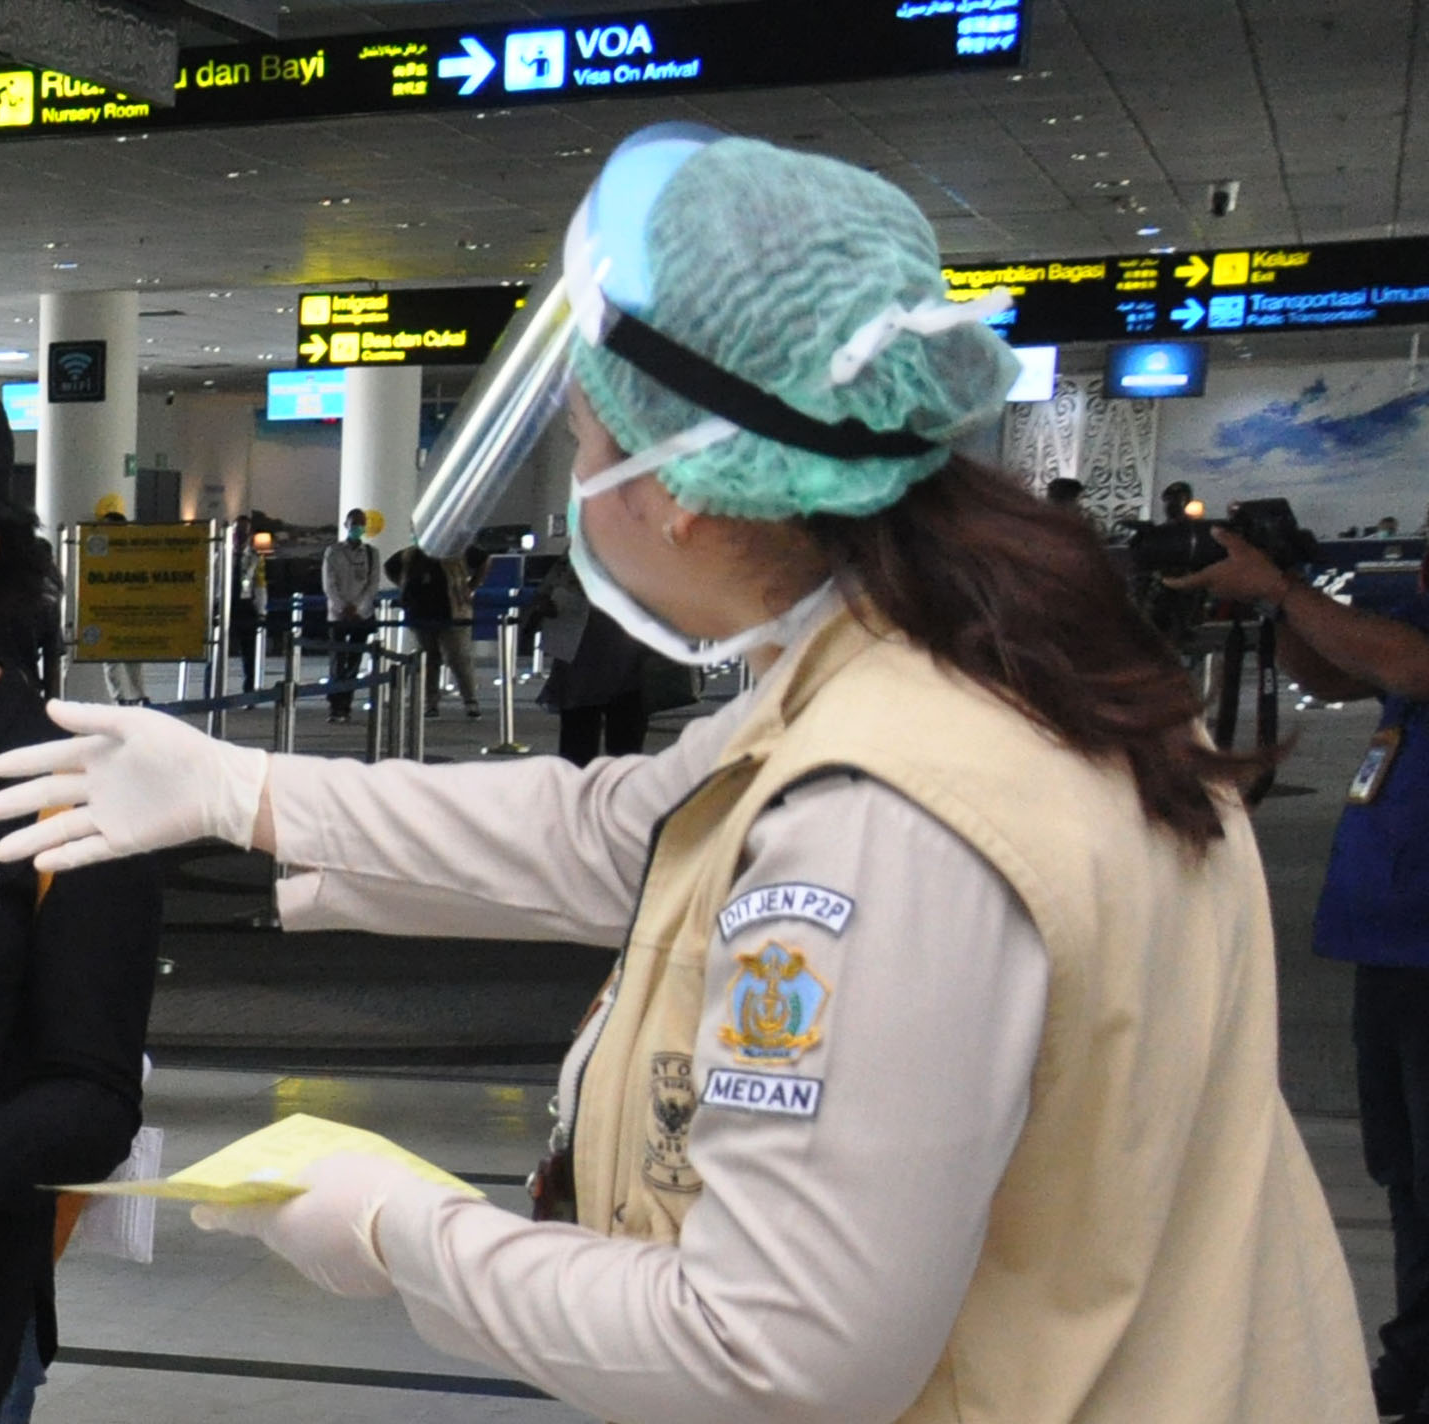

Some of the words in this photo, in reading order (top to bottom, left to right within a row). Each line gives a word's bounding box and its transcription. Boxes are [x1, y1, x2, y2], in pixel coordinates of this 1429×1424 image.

[575, 24, 653, 59] VOA
[196, 60, 251, 88] dan
[261, 49, 325, 95] Bayi
[573, 69, 611, 86] Visa
[613, 65, 640, 83] On
[642, 59, 701, 81] Arrival
[42, 107, 102, 124] Nursery
[103, 103, 149, 119] Room
[1048, 261, 1106, 283] Bagasi
[1249, 288, 1367, 313] Transportasi
[802, 892, 845, 920] P2P
[710, 1075, 813, 1110] MEDAN
